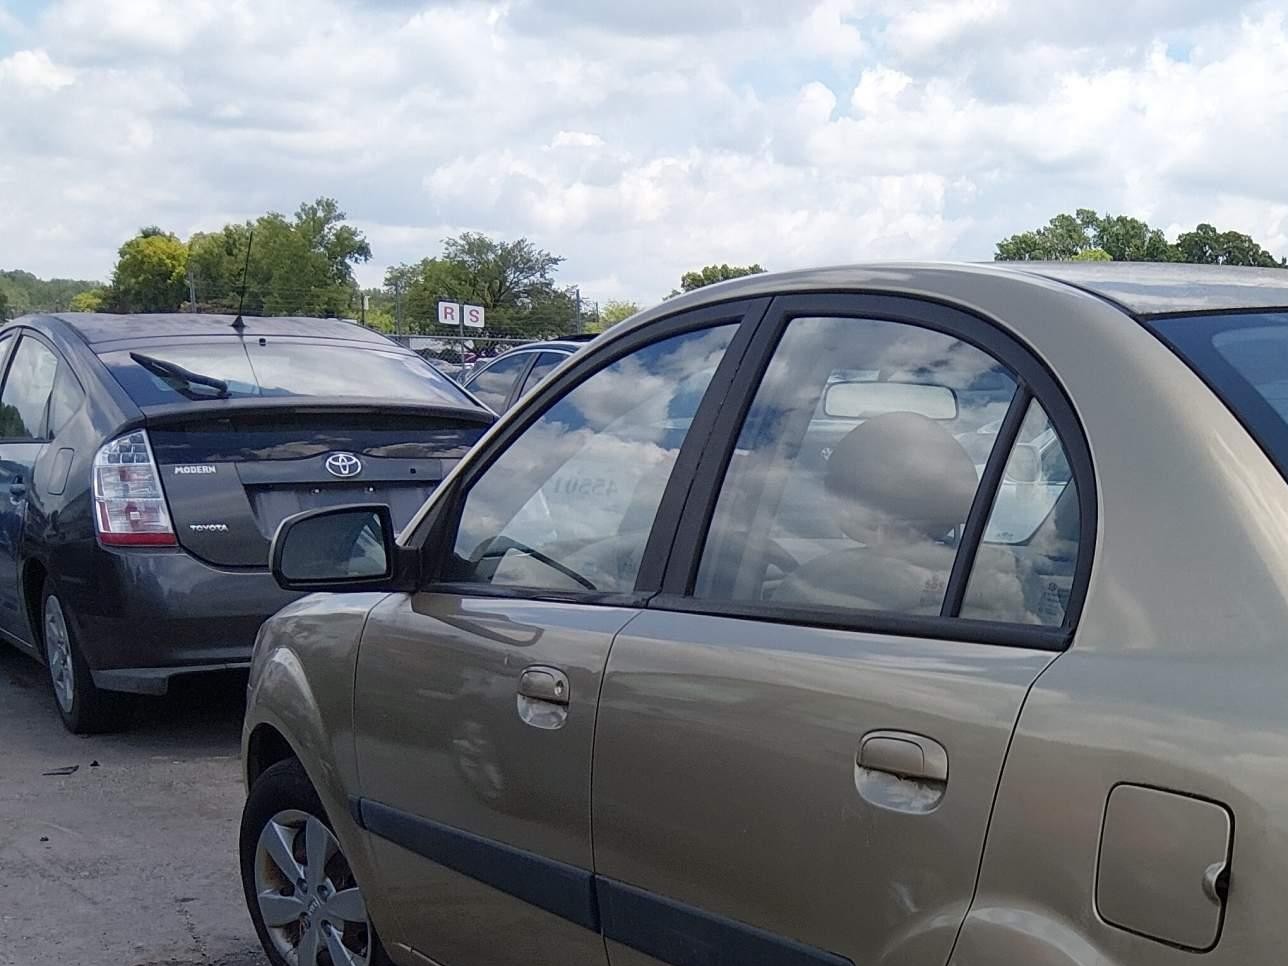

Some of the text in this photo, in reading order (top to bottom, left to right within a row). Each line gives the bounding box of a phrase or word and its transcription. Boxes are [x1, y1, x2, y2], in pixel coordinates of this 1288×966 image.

[444, 306, 480, 323] R S
[174, 465, 217, 474] MODERN
[189, 524, 229, 532] TOYOTA
